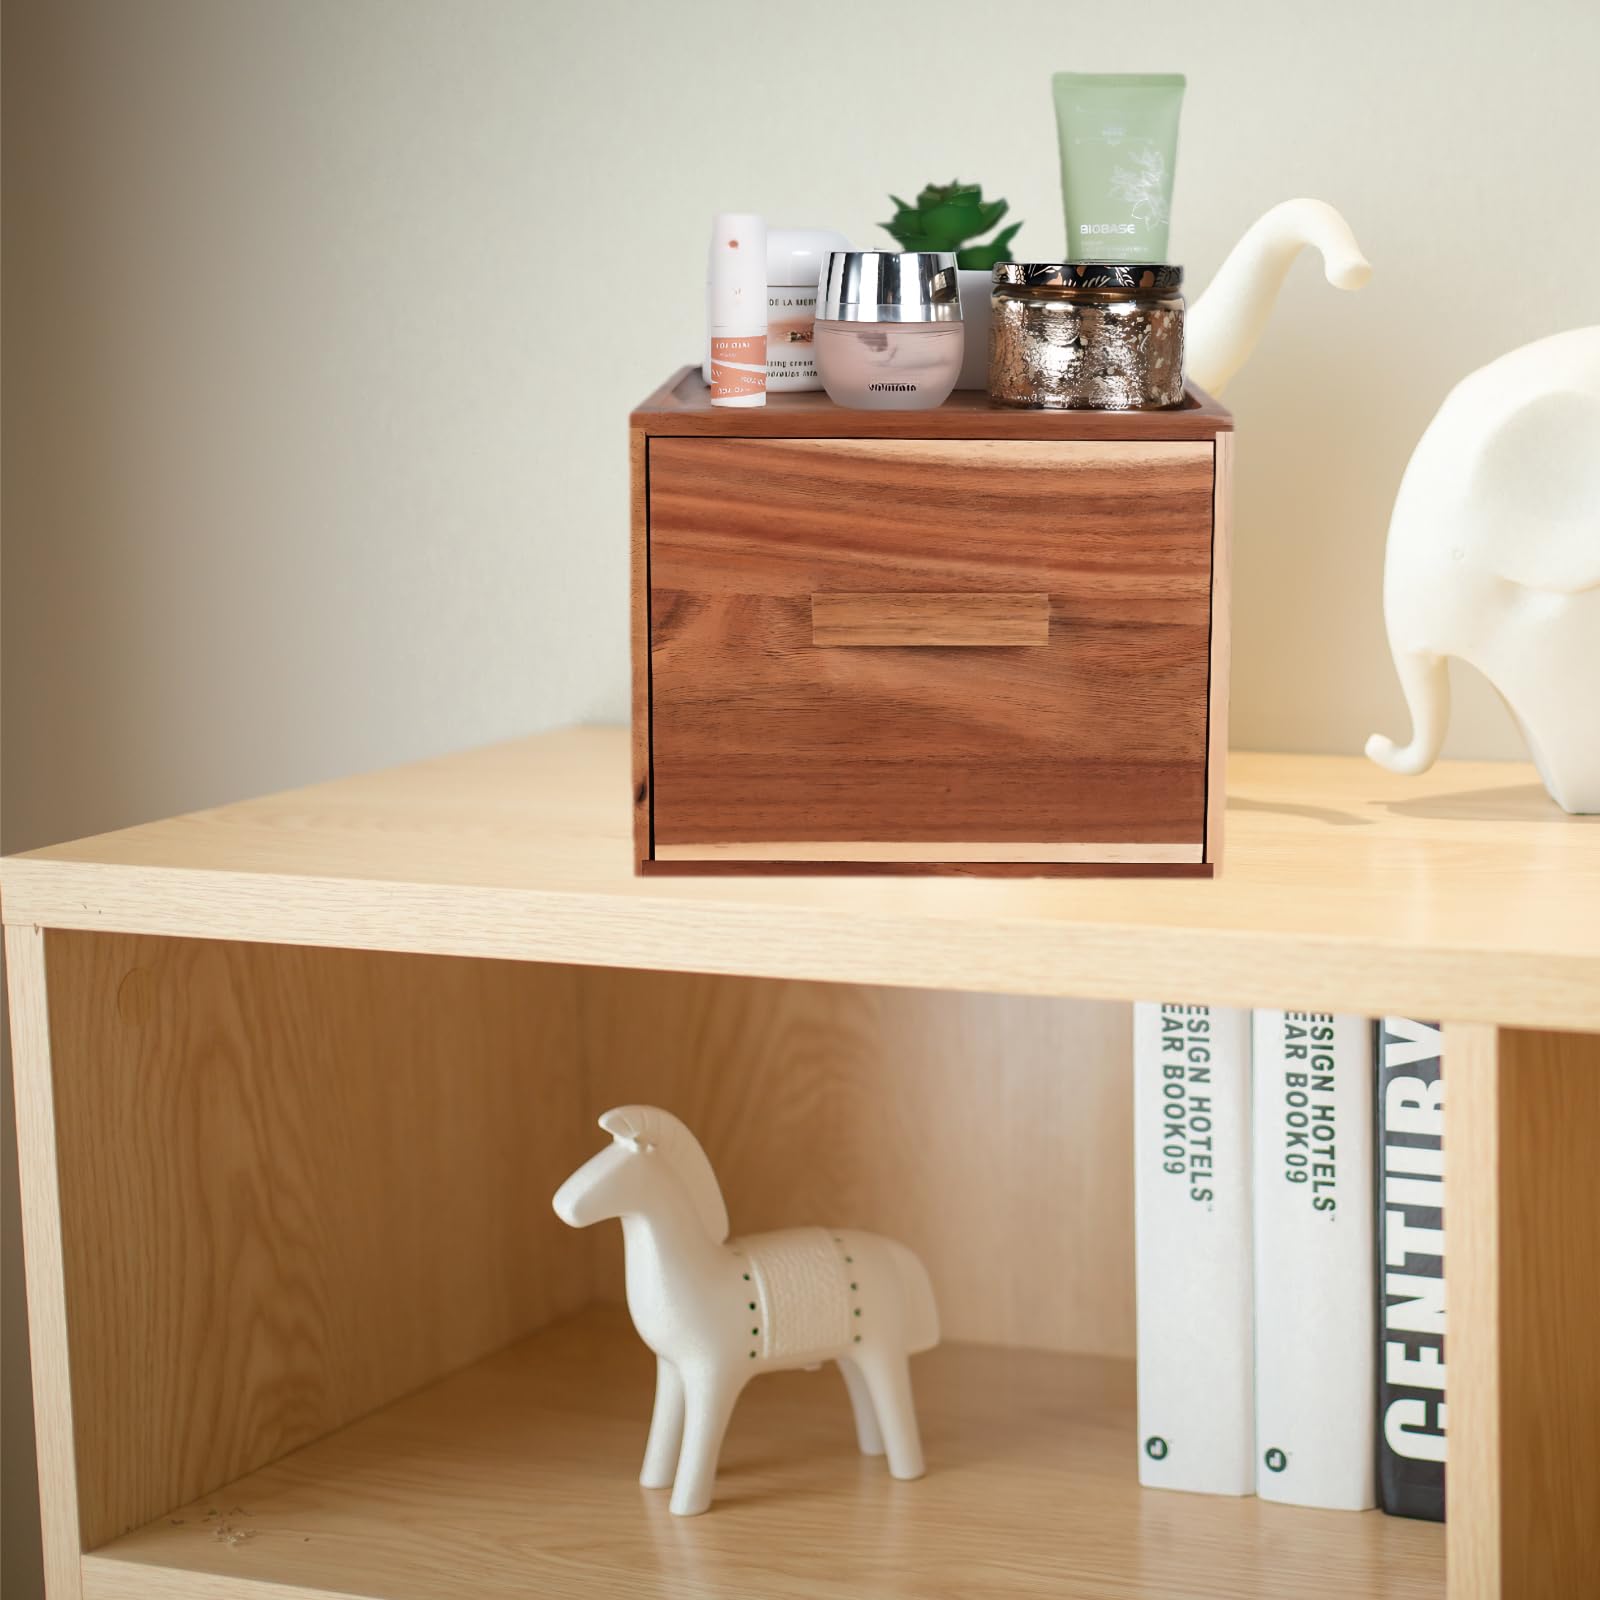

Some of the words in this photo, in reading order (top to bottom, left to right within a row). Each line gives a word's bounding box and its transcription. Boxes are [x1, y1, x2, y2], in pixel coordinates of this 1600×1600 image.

[1080, 224, 1136, 234] BIOBASE
[1189, 1096, 1213, 1202] HOTELS
[1311, 1104, 1336, 1212] HOTELS
